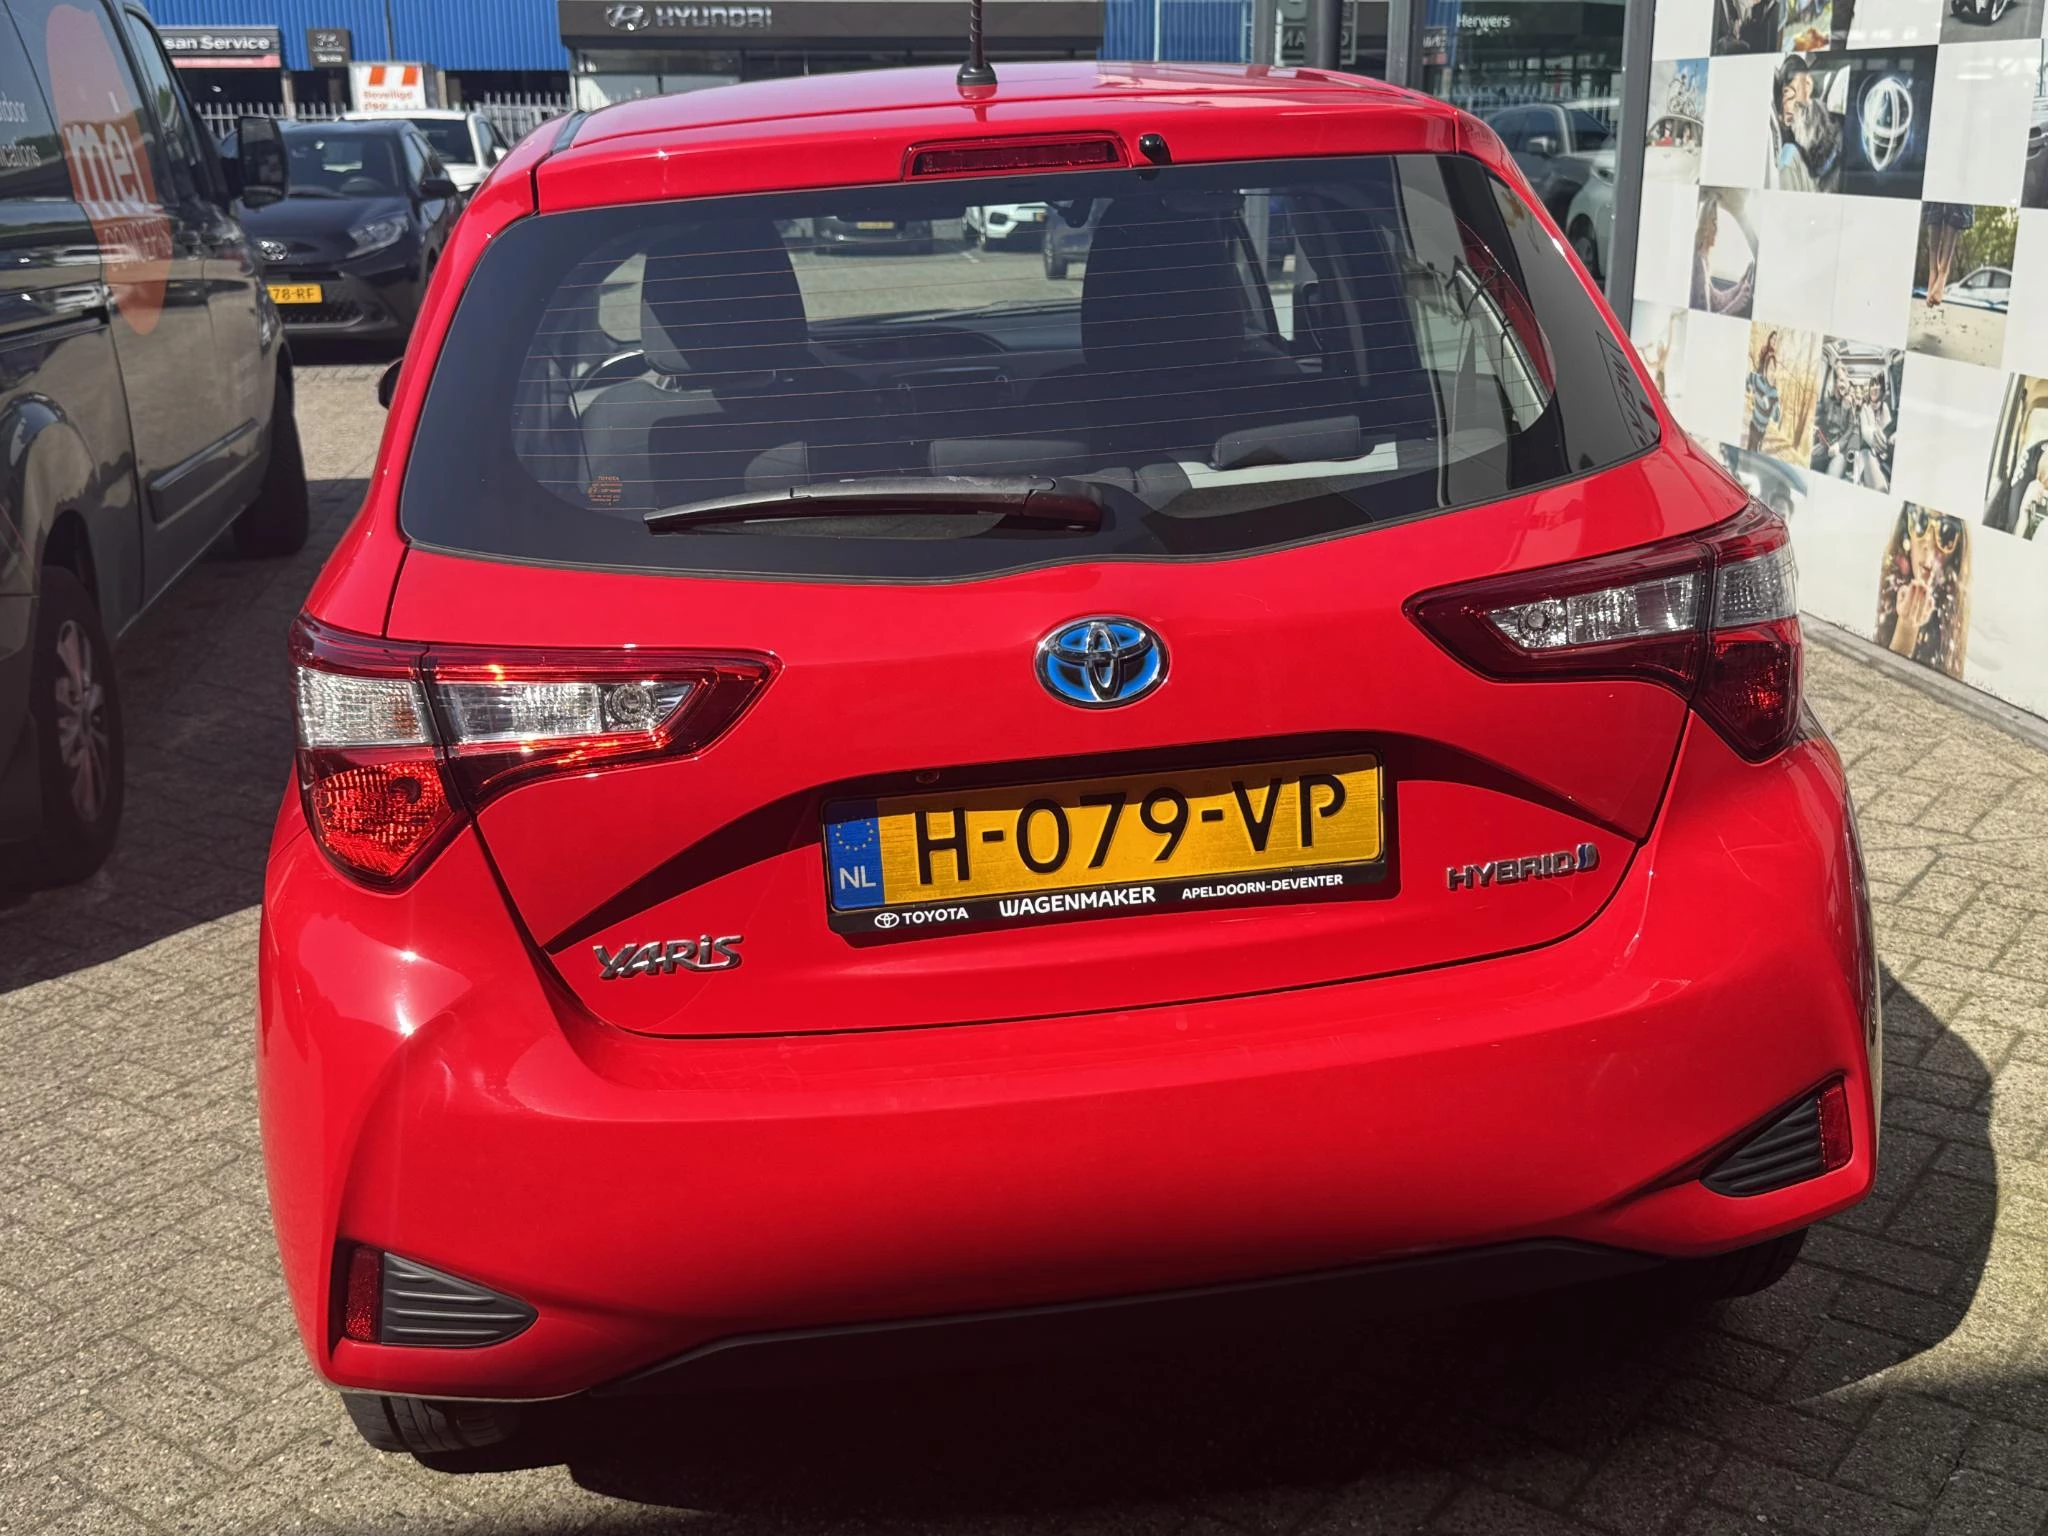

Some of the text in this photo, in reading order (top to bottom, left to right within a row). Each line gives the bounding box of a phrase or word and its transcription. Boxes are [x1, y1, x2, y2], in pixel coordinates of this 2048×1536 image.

[655, 6, 772, 27] HYUNDAI
[1456, 13, 1511, 28] Herwers
[200, 34, 270, 50] Service
[914, 773, 1347, 886] H-079-VP
[838, 866, 877, 891] NL
[1446, 850, 1577, 889] HYBRID
[901, 873, 1345, 926] TOYOTA WAGENMAKER APELDOORN-DEVENTER
